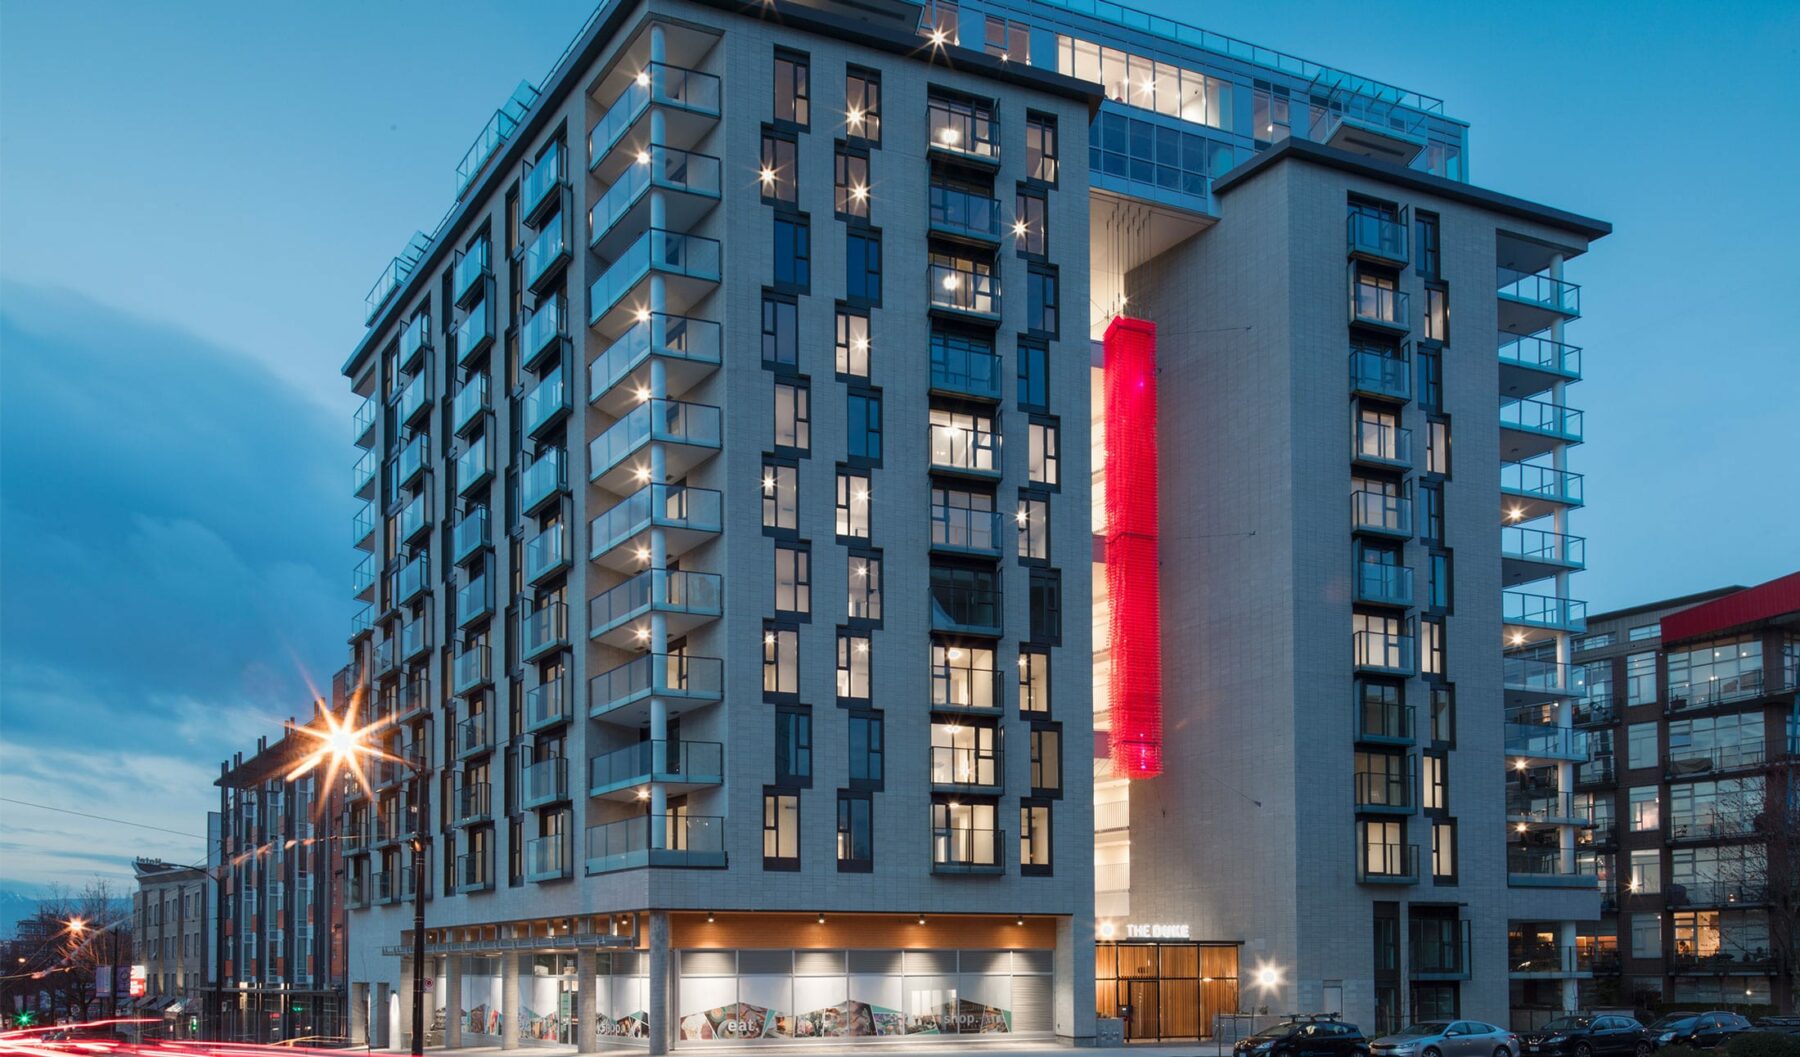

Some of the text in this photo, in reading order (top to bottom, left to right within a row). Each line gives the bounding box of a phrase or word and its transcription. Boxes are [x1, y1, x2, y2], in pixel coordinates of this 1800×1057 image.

[1126, 924, 1190, 938] THE DUKE
[727, 1019, 760, 1032] eat.
[943, 1014, 979, 1027] shop.
